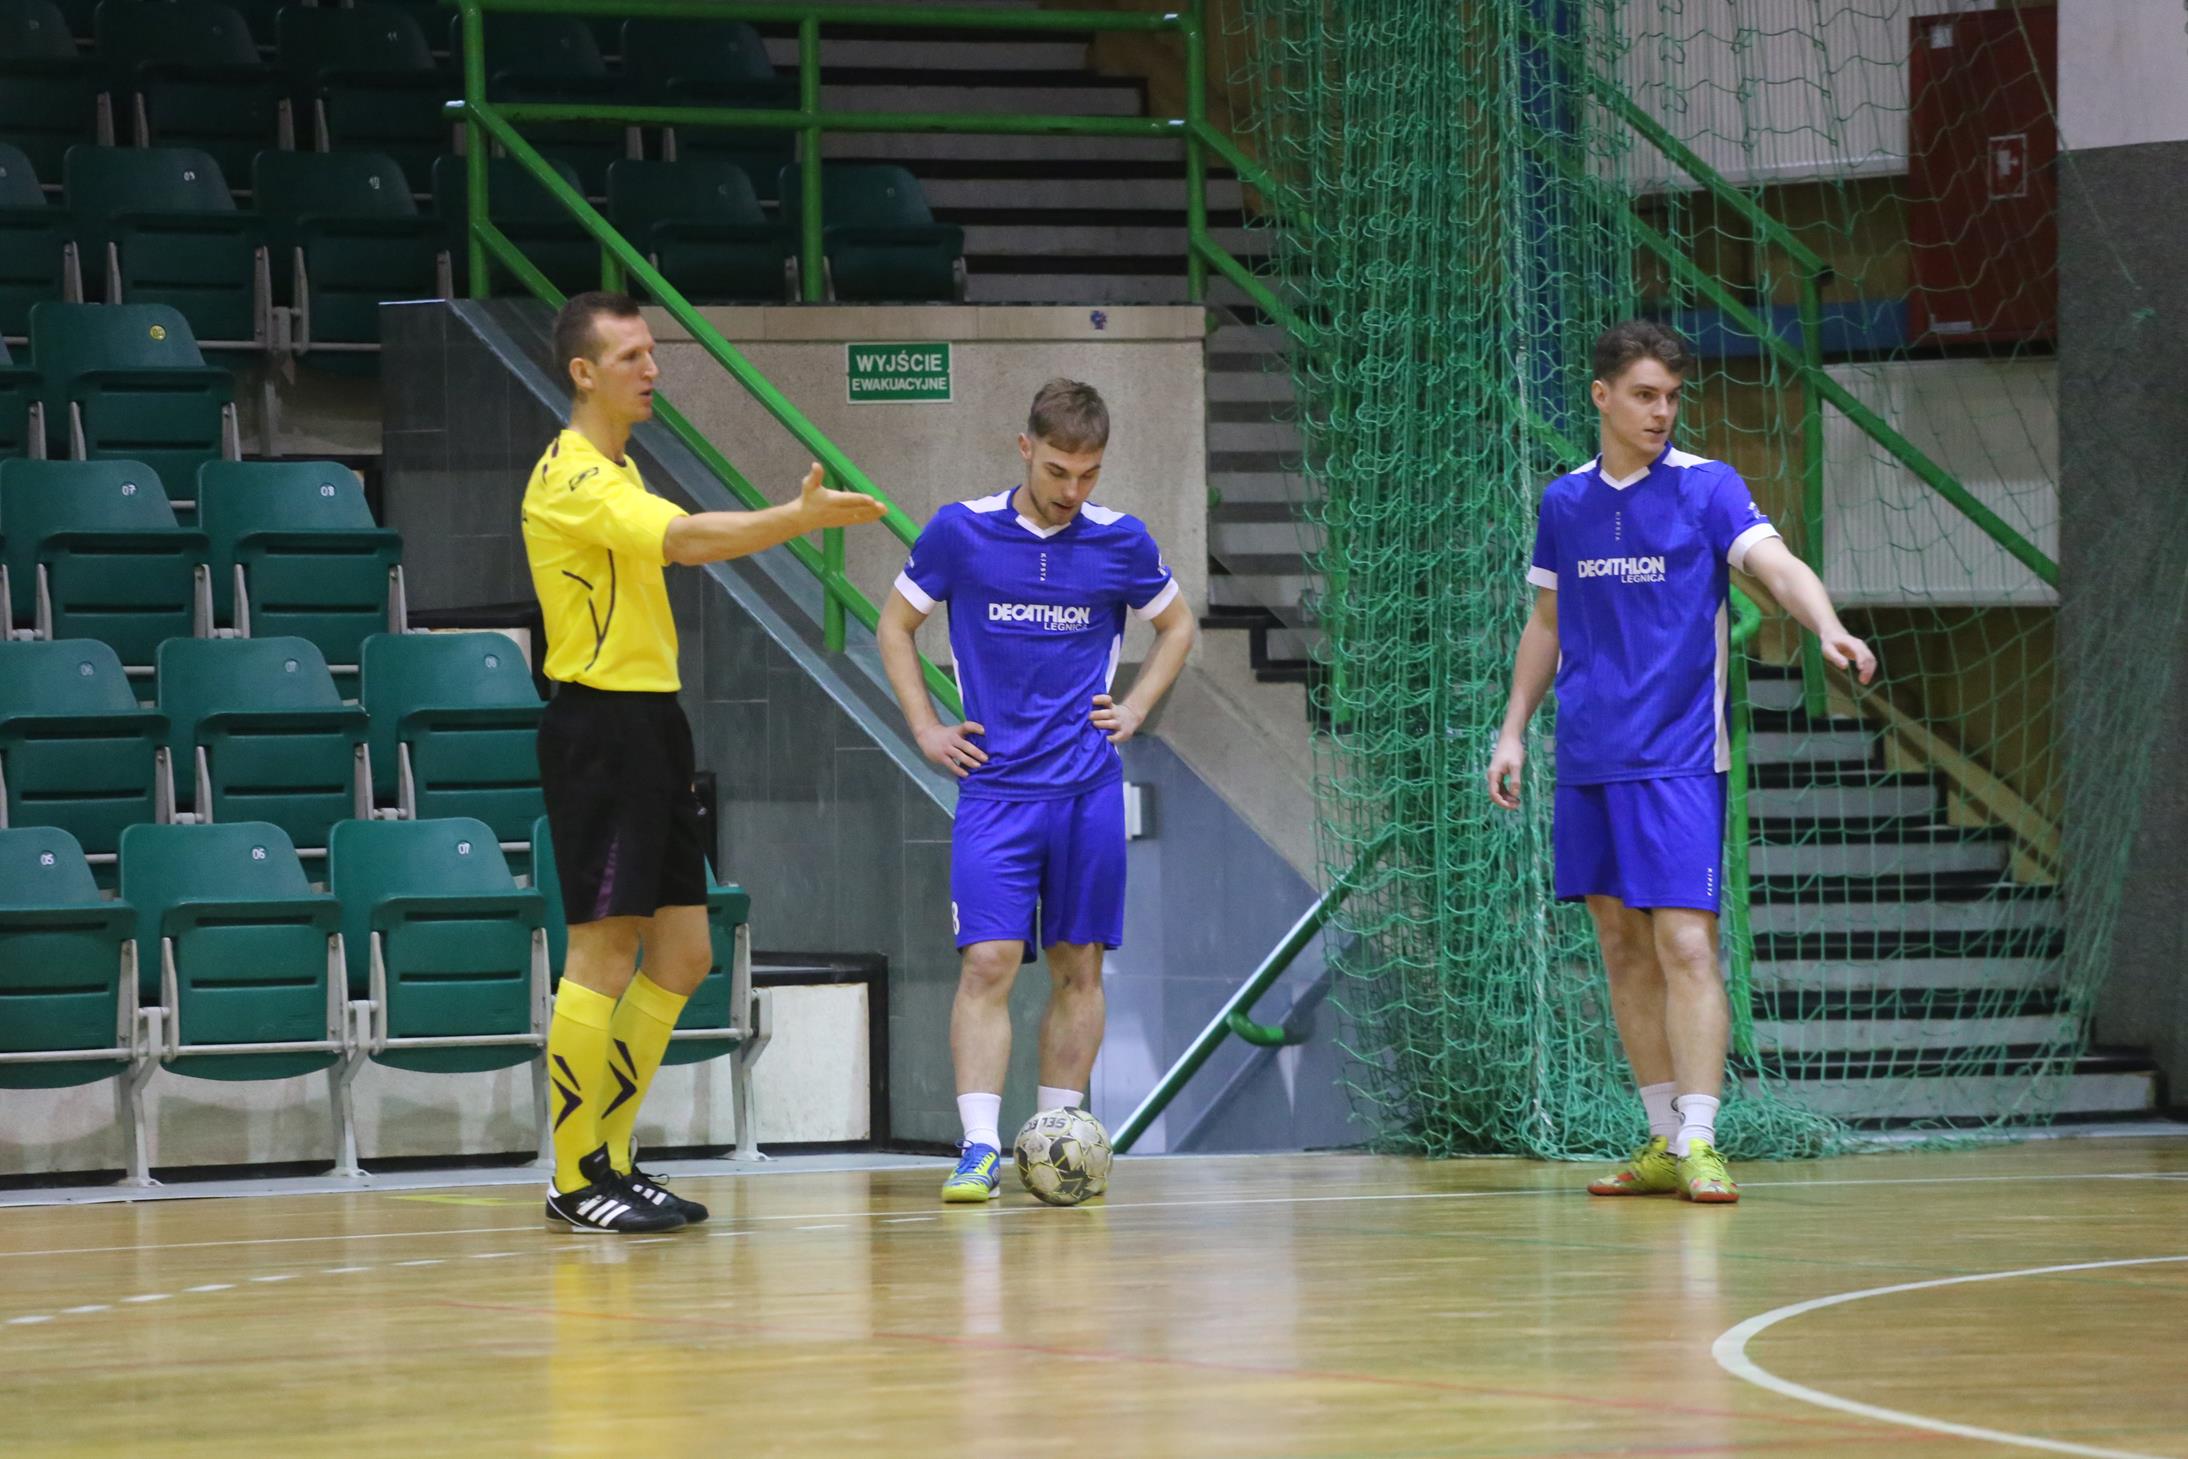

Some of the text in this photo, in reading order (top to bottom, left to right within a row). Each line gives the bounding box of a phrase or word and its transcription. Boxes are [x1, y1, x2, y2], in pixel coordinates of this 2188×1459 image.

[856, 350, 942, 372] WYJŚCIE
[852, 377, 947, 391] EWAKUACYJNE
[320, 485, 335, 497] 08
[1577, 556, 1665, 578] DECATHLON
[1621, 574, 1665, 583] LEGNICA
[988, 603, 1090, 624] DECATHLON
[458, 842, 471, 855] 07
[1021, 1117, 1067, 1135] SELEC
